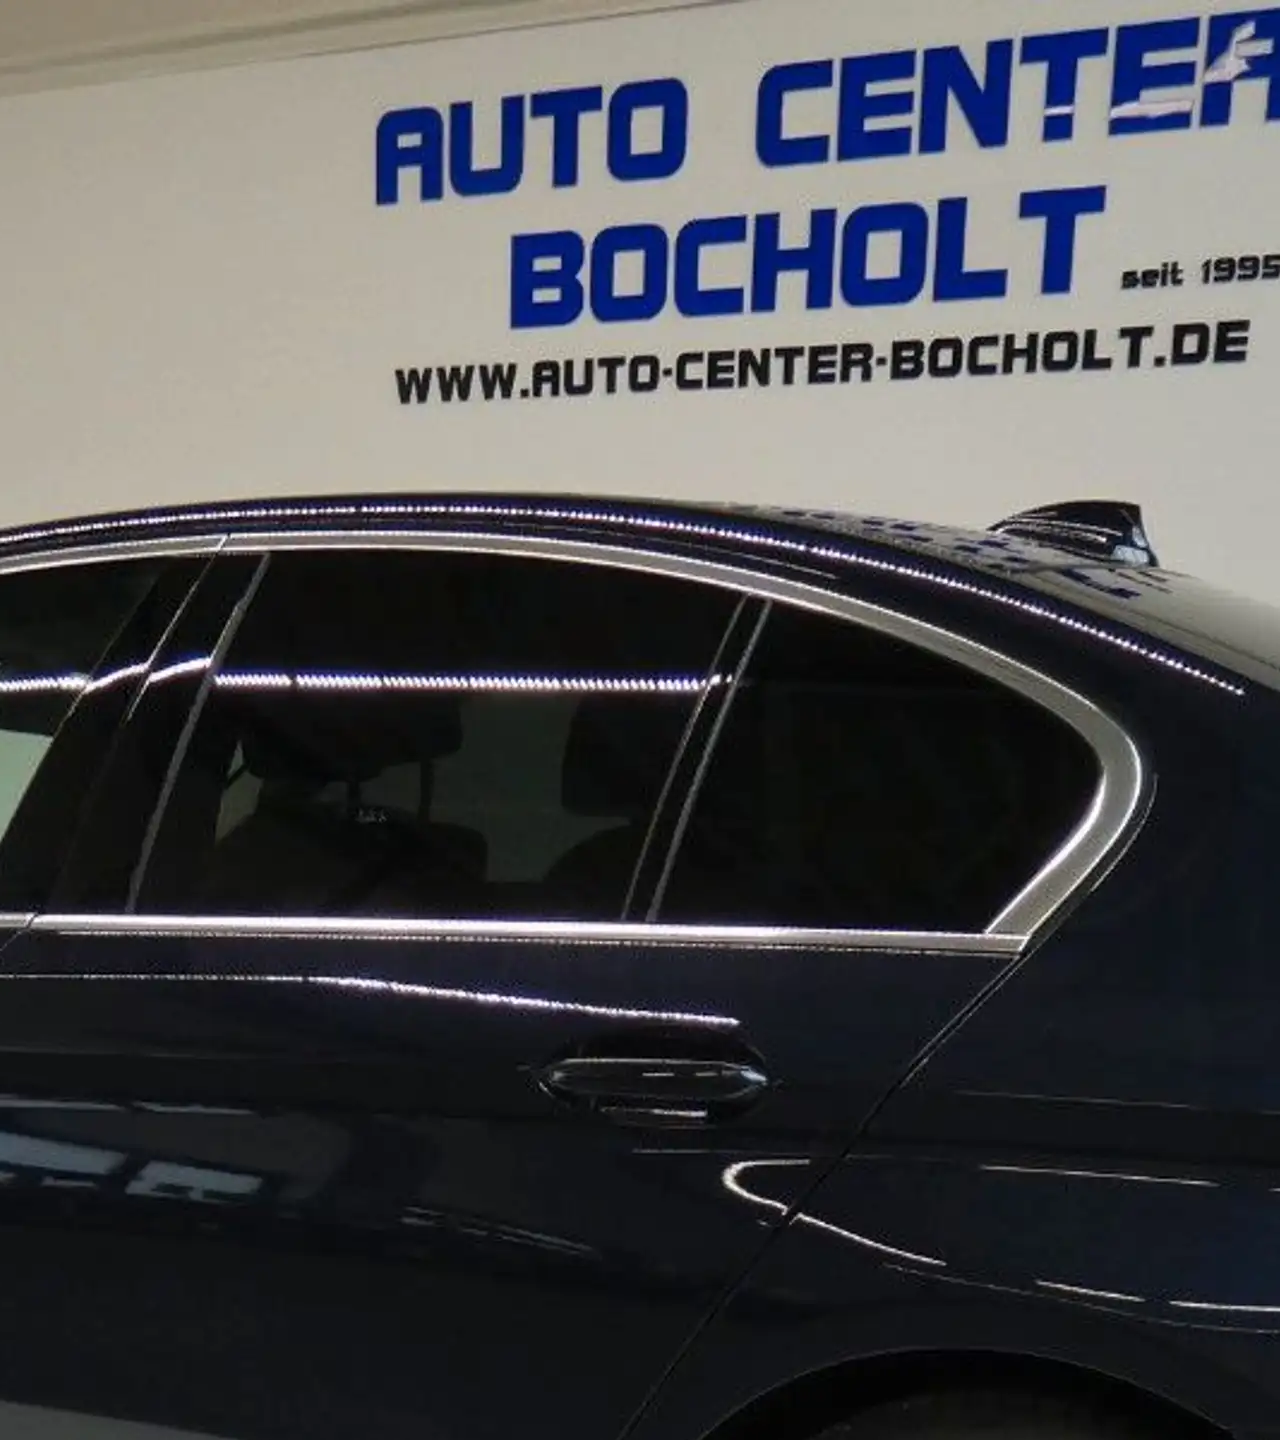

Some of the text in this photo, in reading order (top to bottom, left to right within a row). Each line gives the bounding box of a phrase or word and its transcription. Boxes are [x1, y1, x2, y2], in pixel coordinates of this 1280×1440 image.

[375, 77, 689, 206] AUTO
[509, 184, 1107, 330] BOCHOLT
[1121, 261, 1184, 290] seit
[394, 319, 1252, 406] WWW.AUTO-CENTER-BOCHOLT.DE
